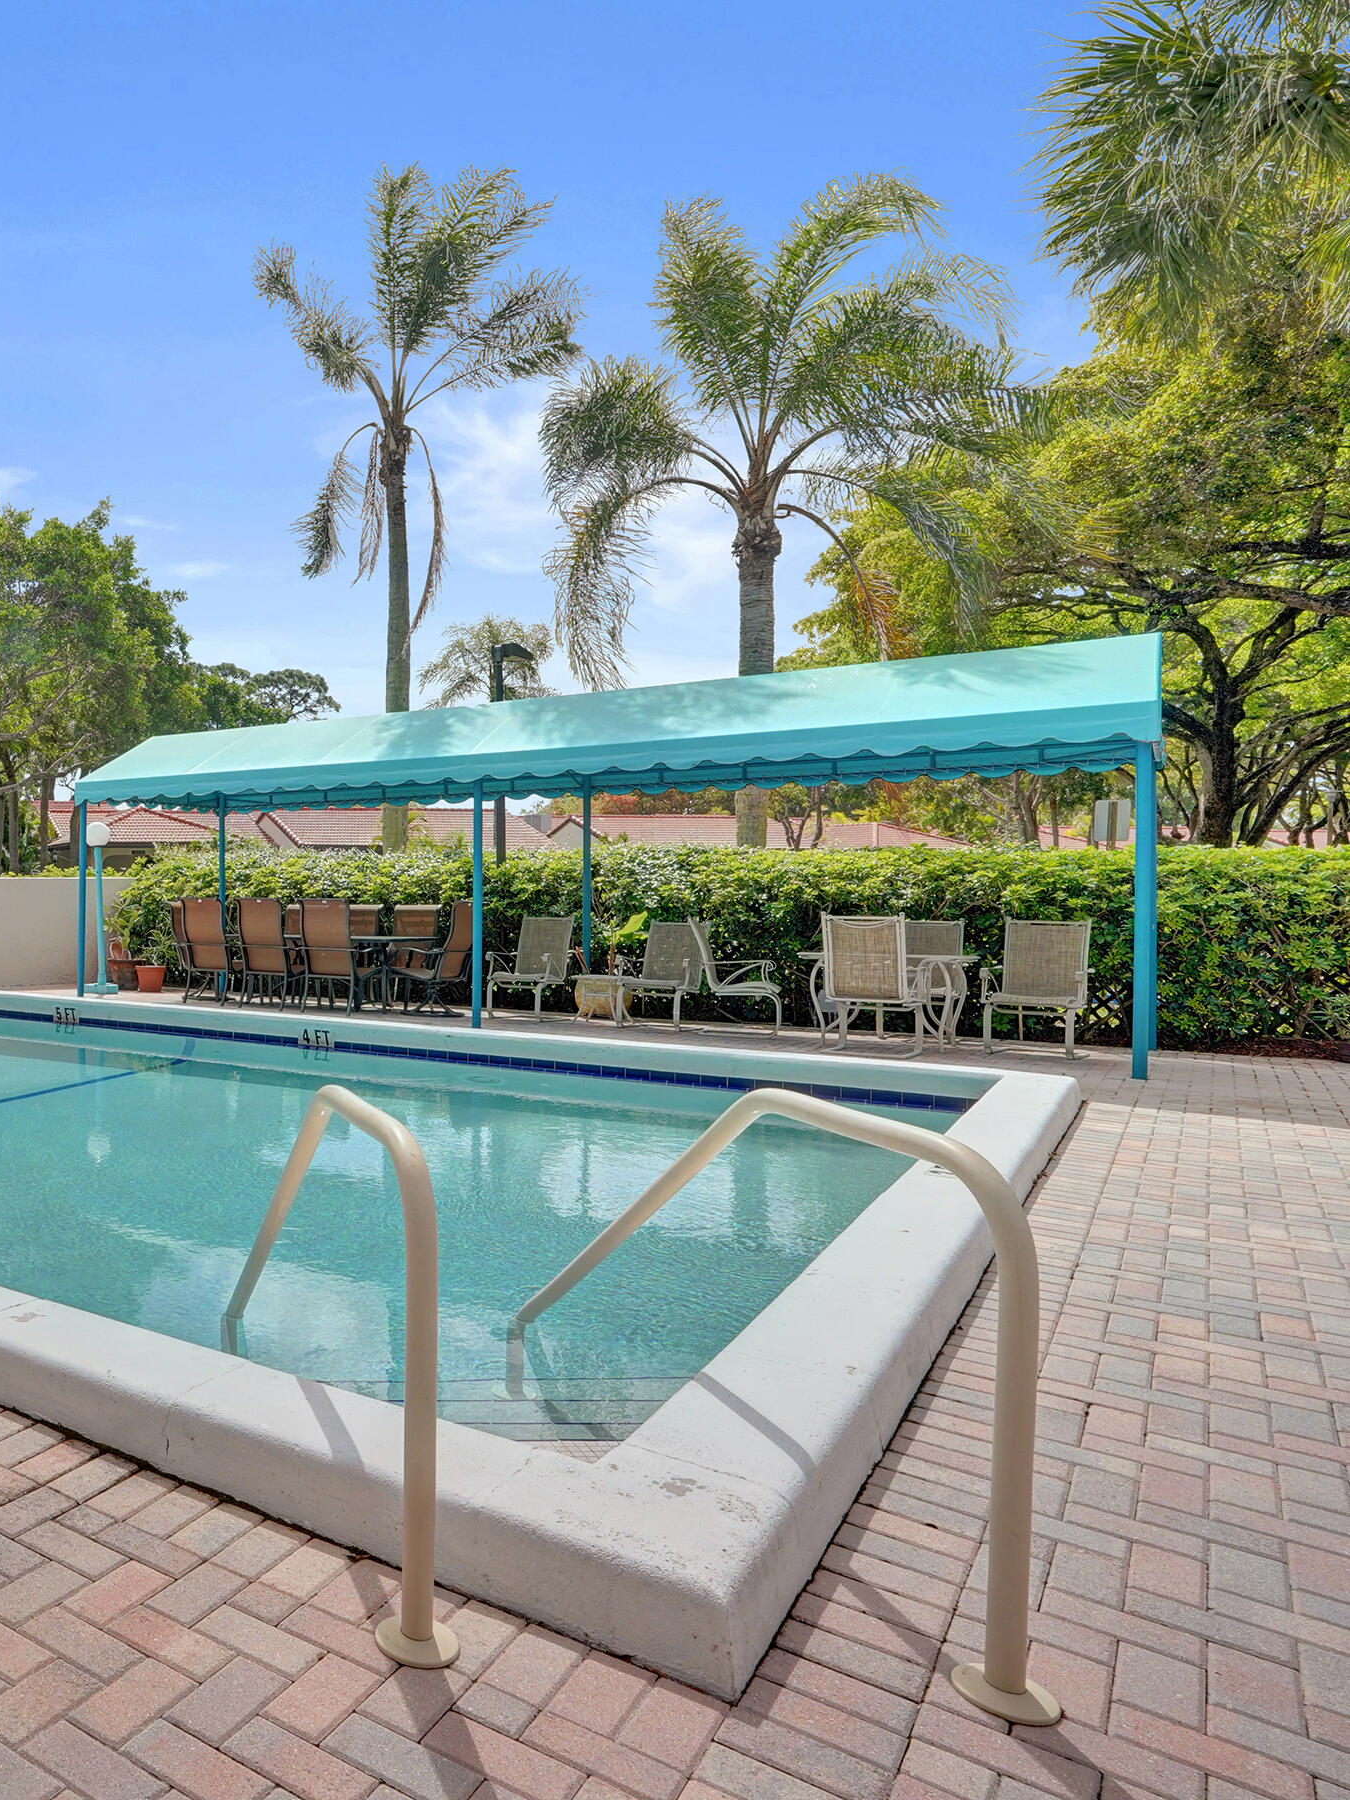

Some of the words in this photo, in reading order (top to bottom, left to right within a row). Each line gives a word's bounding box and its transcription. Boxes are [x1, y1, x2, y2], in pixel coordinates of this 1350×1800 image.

[55, 1007, 62, 1021] 5
[64, 1008, 76, 1022] FT
[302, 1028, 310, 1044] 4
[314, 1029, 330, 1046] FT
